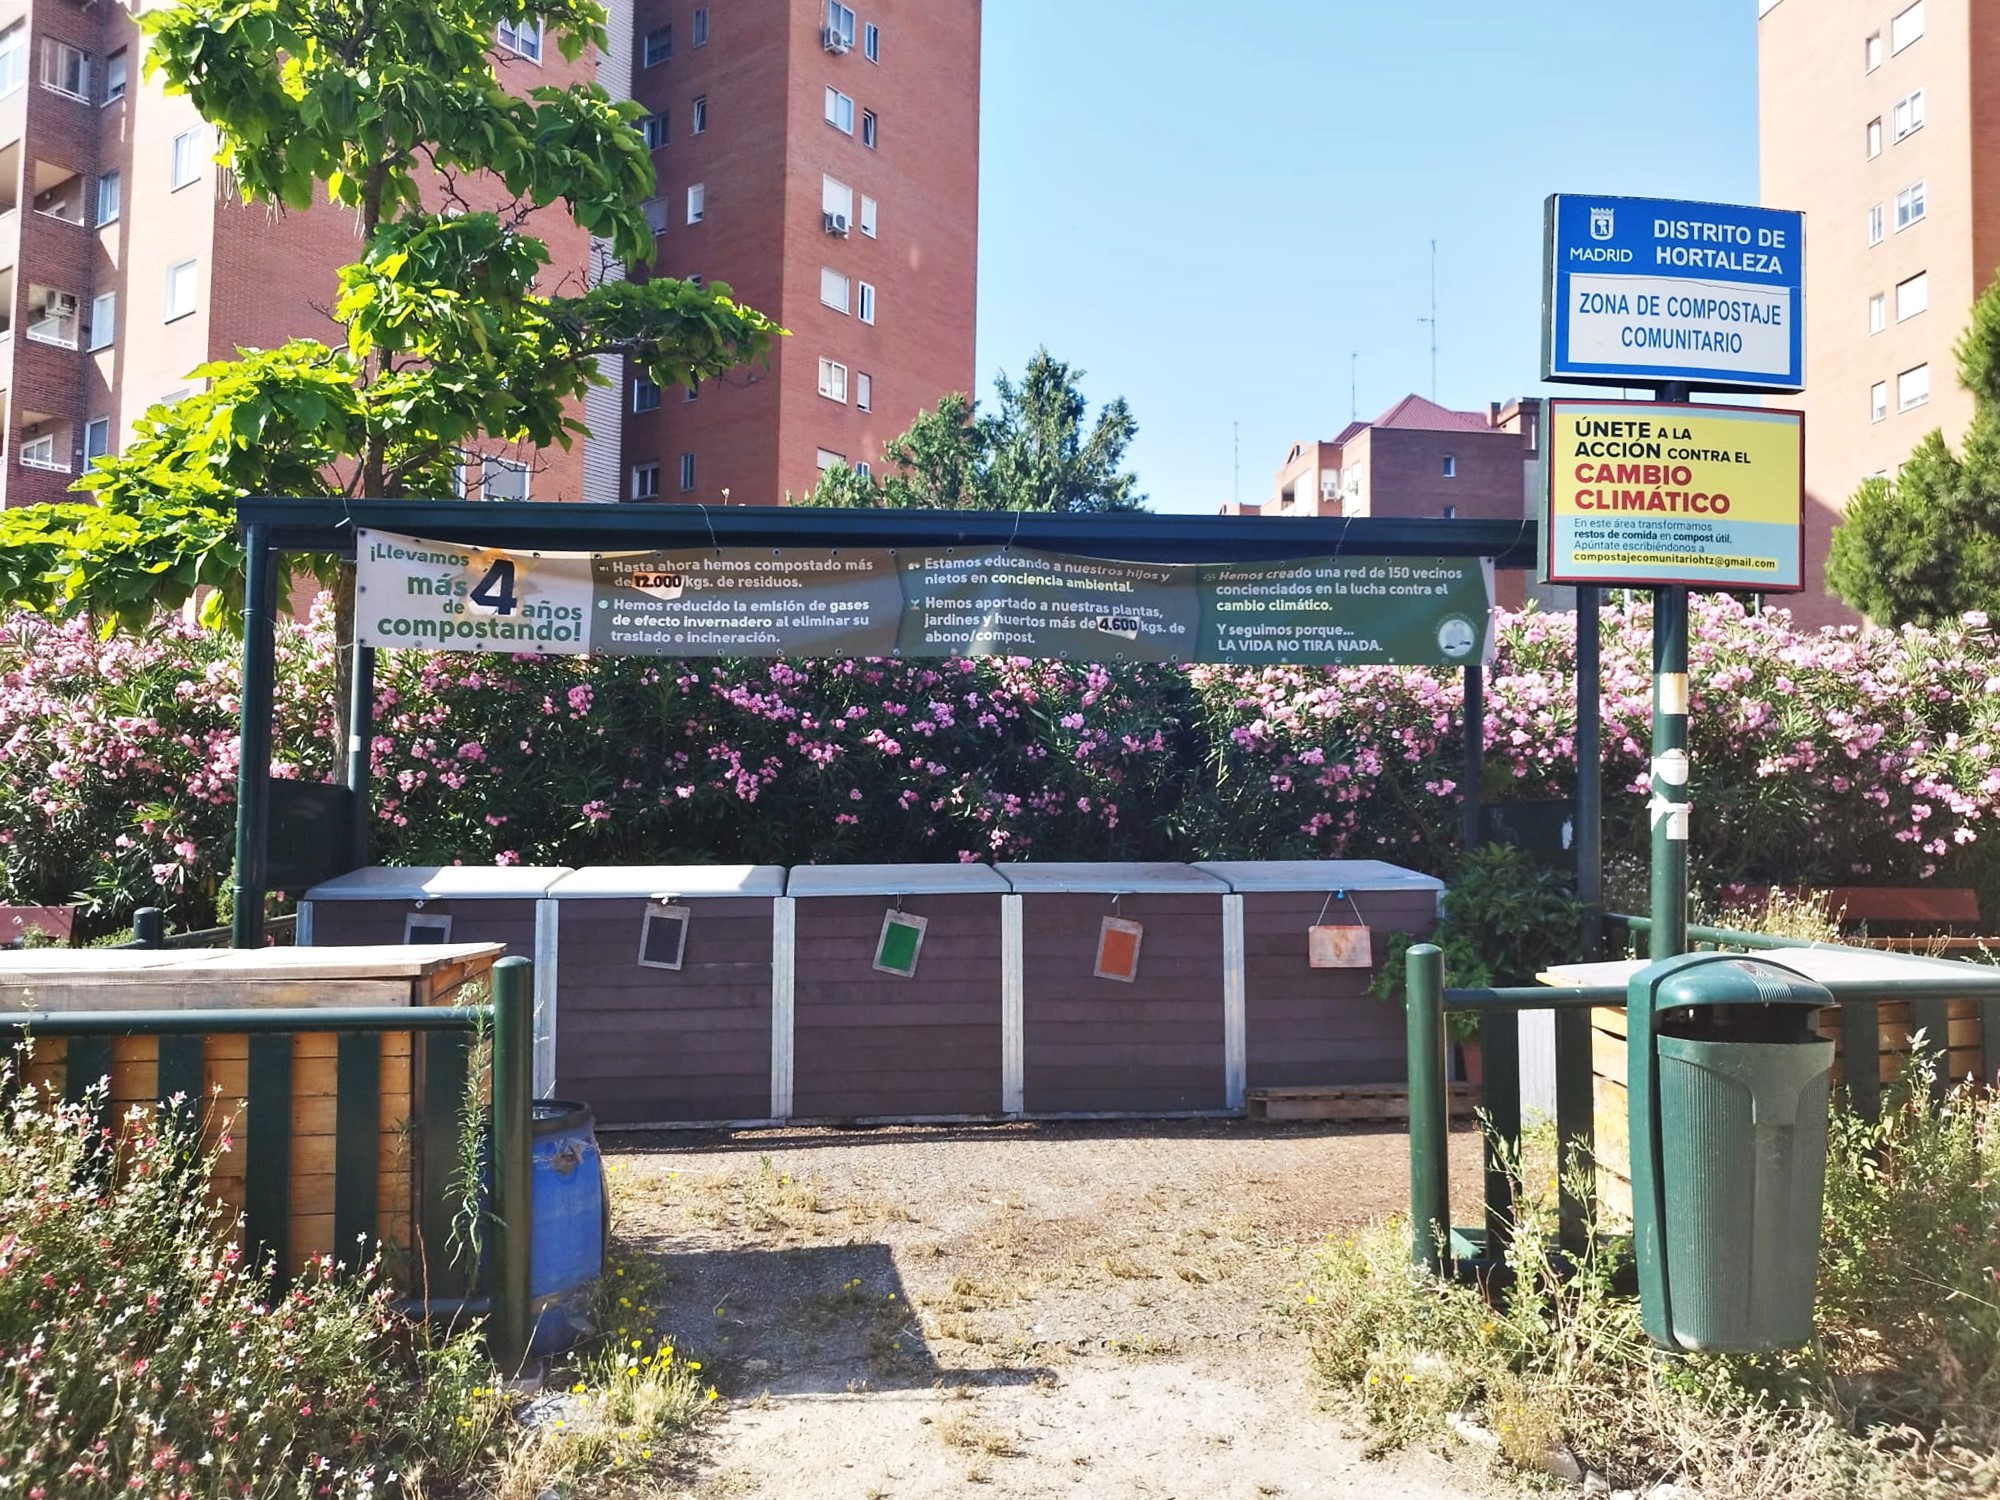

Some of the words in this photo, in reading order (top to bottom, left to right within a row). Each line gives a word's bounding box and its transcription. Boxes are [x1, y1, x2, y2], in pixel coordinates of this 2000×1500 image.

[1654, 219, 1751, 245] DISTRITO
[1758, 229, 1785, 248] DE
[1570, 247, 1633, 263] MADRID
[1656, 246, 1783, 274] HORTALEZA
[1579, 293, 1629, 315] ZONA
[1637, 295, 1660, 316] DE
[1667, 296, 1781, 325] COMPOSTAJE
[1621, 326, 1742, 354] COMUNITARIO
[1575, 417, 1650, 438] ÚNETE
[1657, 427, 1668, 439] A
[1673, 428, 1692, 440] LA
[1574, 438, 1661, 459] ACCIÓN
[1667, 448, 1731, 463] CONTRA
[1735, 451, 1751, 464] EL
[1575, 463, 1692, 486] CAMBIO
[1575, 486, 1730, 514] CLIMÁTICO
[1574, 518, 1587, 528] En
[1589, 520, 1612, 529] este
[1614, 518, 1636, 530] área
[1638, 520, 1713, 531] transformamos
[1574, 530, 1605, 539] restos
[1607, 531, 1619, 539] de
[1622, 531, 1657, 540] comida
[1660, 533, 1671, 541] en
[1673, 533, 1714, 545] compost
[1715, 534, 1733, 544] útil.
[1574, 540, 1620, 552] Apúntate
[1622, 541, 1696, 553] escribiéndonos
[1699, 545, 1705, 553] a
[370, 543, 469, 566] ¡Llevamos
[1574, 553, 1776, 569] compostajecomunitariohtz@gmail.com
[612, 561, 653, 573] Hasta
[657, 560, 700, 572] ahora
[704, 558, 750, 571] hemos
[754, 559, 841, 573] compostado
[845, 558, 873, 571] más
[924, 558, 981, 570] Estamos
[984, 555, 1050, 571] educando
[1053, 562, 1061, 572] a
[1064, 562, 1123, 576] nuestros
[1126, 569, 1158, 580] hijos
[1161, 573, 1171, 582] y
[1219, 571, 1263, 580] Hemos
[1266, 567, 1312, 578] creado
[1315, 568, 1340, 578] una
[1343, 566, 1366, 578] red
[1369, 567, 1386, 578] de
[1388, 567, 1410, 578] 150
[1412, 568, 1462, 579] vecinos
[407, 573, 467, 596] más
[469, 558, 517, 615] 4
[614, 577, 632, 587] de
[685, 575, 713, 590] kgs.
[716, 576, 734, 588] de
[737, 576, 802, 588] residuos.
[925, 573, 967, 585] nietos
[970, 574, 987, 584] en
[991, 572, 1064, 587] conciencia
[1066, 578, 1134, 593] ambiental.
[1216, 583, 1313, 595] concienciados
[1315, 585, 1332, 594] en
[1335, 583, 1347, 594] la
[1350, 583, 1387, 594] lucha
[1389, 584, 1432, 595] contra
[1434, 583, 1448, 594] el
[443, 599, 464, 614] de
[521, 600, 583, 620] años
[613, 598, 663, 611] Hemos
[666, 600, 730, 612] reducido
[733, 600, 747, 612] la
[750, 600, 805, 612] emisión
[808, 600, 826, 611] de
[829, 601, 870, 613] gases
[925, 596, 972, 609] Hemos
[975, 596, 1037, 611] aportado
[1040, 602, 1048, 611] a
[1051, 601, 1109, 614] nuestras
[1112, 604, 1164, 619] plantas,
[1216, 599, 1265, 611] cambio
[1268, 598, 1333, 611] climático.
[377, 617, 582, 642] compostando!
[612, 614, 630, 626] de
[634, 614, 680, 627] efecto
[683, 615, 772, 628] invernadero
[775, 615, 789, 628] al
[792, 615, 850, 627] eliminar
[852, 616, 869, 625] su
[924, 613, 980, 628] jardines
[983, 614, 992, 628] y
[995, 612, 1046, 628] huertos
[1049, 616, 1077, 629] más
[1080, 617, 1097, 629] de
[1140, 620, 1167, 634] kgs.
[1169, 623, 1186, 634] de
[610, 630, 671, 642] traslado
[674, 634, 684, 643] e
[687, 631, 780, 644] incineración.
[925, 630, 1036, 644] abono/compost.
[1216, 623, 1227, 635] Y
[1229, 624, 1292, 638] seguimos
[1295, 626, 1354, 638] porque...
[1218, 640, 1236, 651] LA
[1238, 640, 1274, 651] VIDA
[1276, 640, 1299, 651] NO
[1302, 640, 1335, 651] TIRA
[1337, 640, 1383, 651] NADA.
